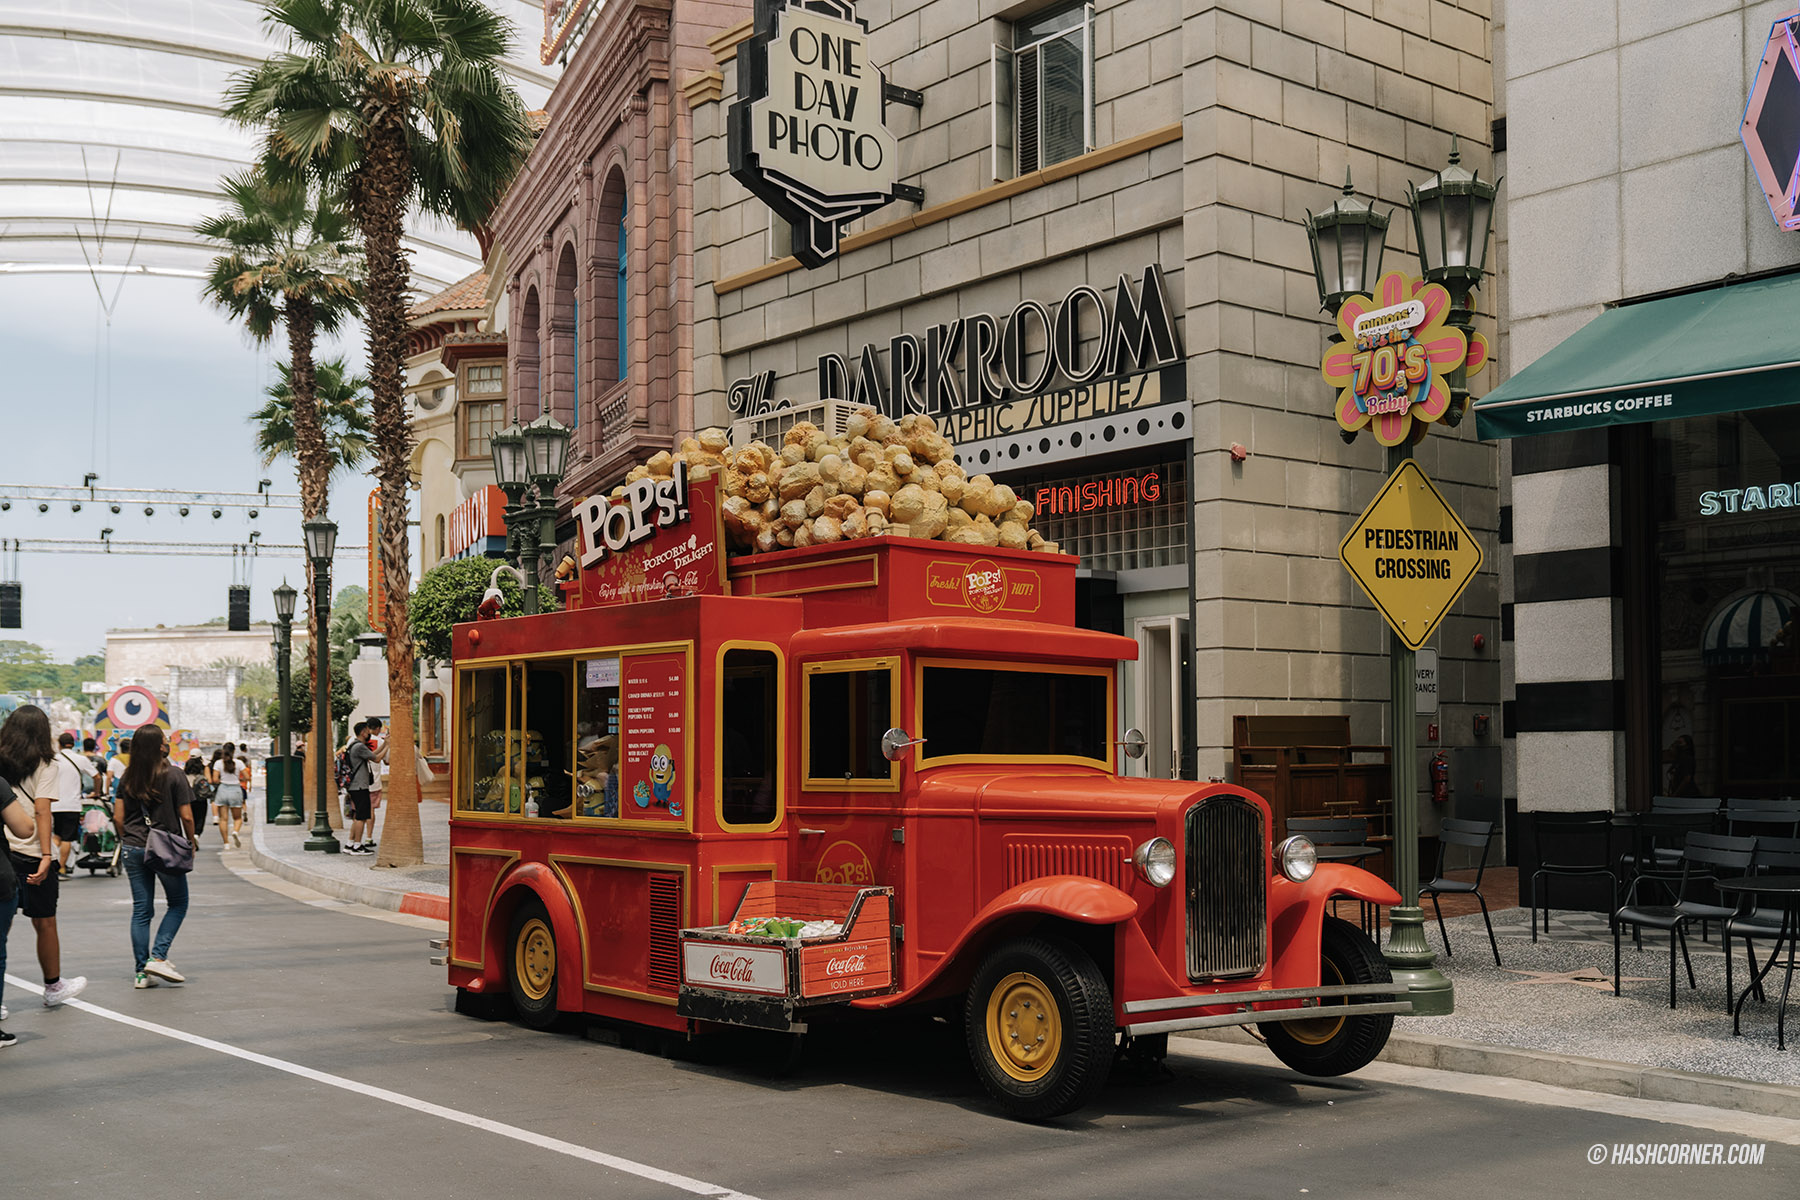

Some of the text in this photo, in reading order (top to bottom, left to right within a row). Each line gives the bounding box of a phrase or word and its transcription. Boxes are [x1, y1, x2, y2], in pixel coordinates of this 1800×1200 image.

[790, 27, 861, 79] ONE
[794, 71, 859, 122] DAY
[769, 110, 883, 172] PHOTO
[817, 263, 1179, 424] DARKROOM
[936, 371, 1149, 445] APHIC SUPPLIES
[1366, 392, 1411, 416] Baby
[1527, 394, 1673, 422] STARBUCKS COFFEE
[1036, 472, 1160, 516] FINISHING
[1365, 528, 1459, 551] PEDESTRIAN
[642, 541, 687, 572] POPCORN
[674, 542, 713, 570] DELIGHT
[1375, 557, 1451, 580] CROSSING
[599, 582, 616, 600] Enjoy
[618, 581, 630, 595] with
[636, 577, 665, 596] refreshing
[930, 575, 960, 590] Fresh!
[710, 954, 755, 982] Coca-Cola
[826, 954, 866, 977] Coca-Cola
[830, 977, 865, 990] SOLD HERE
